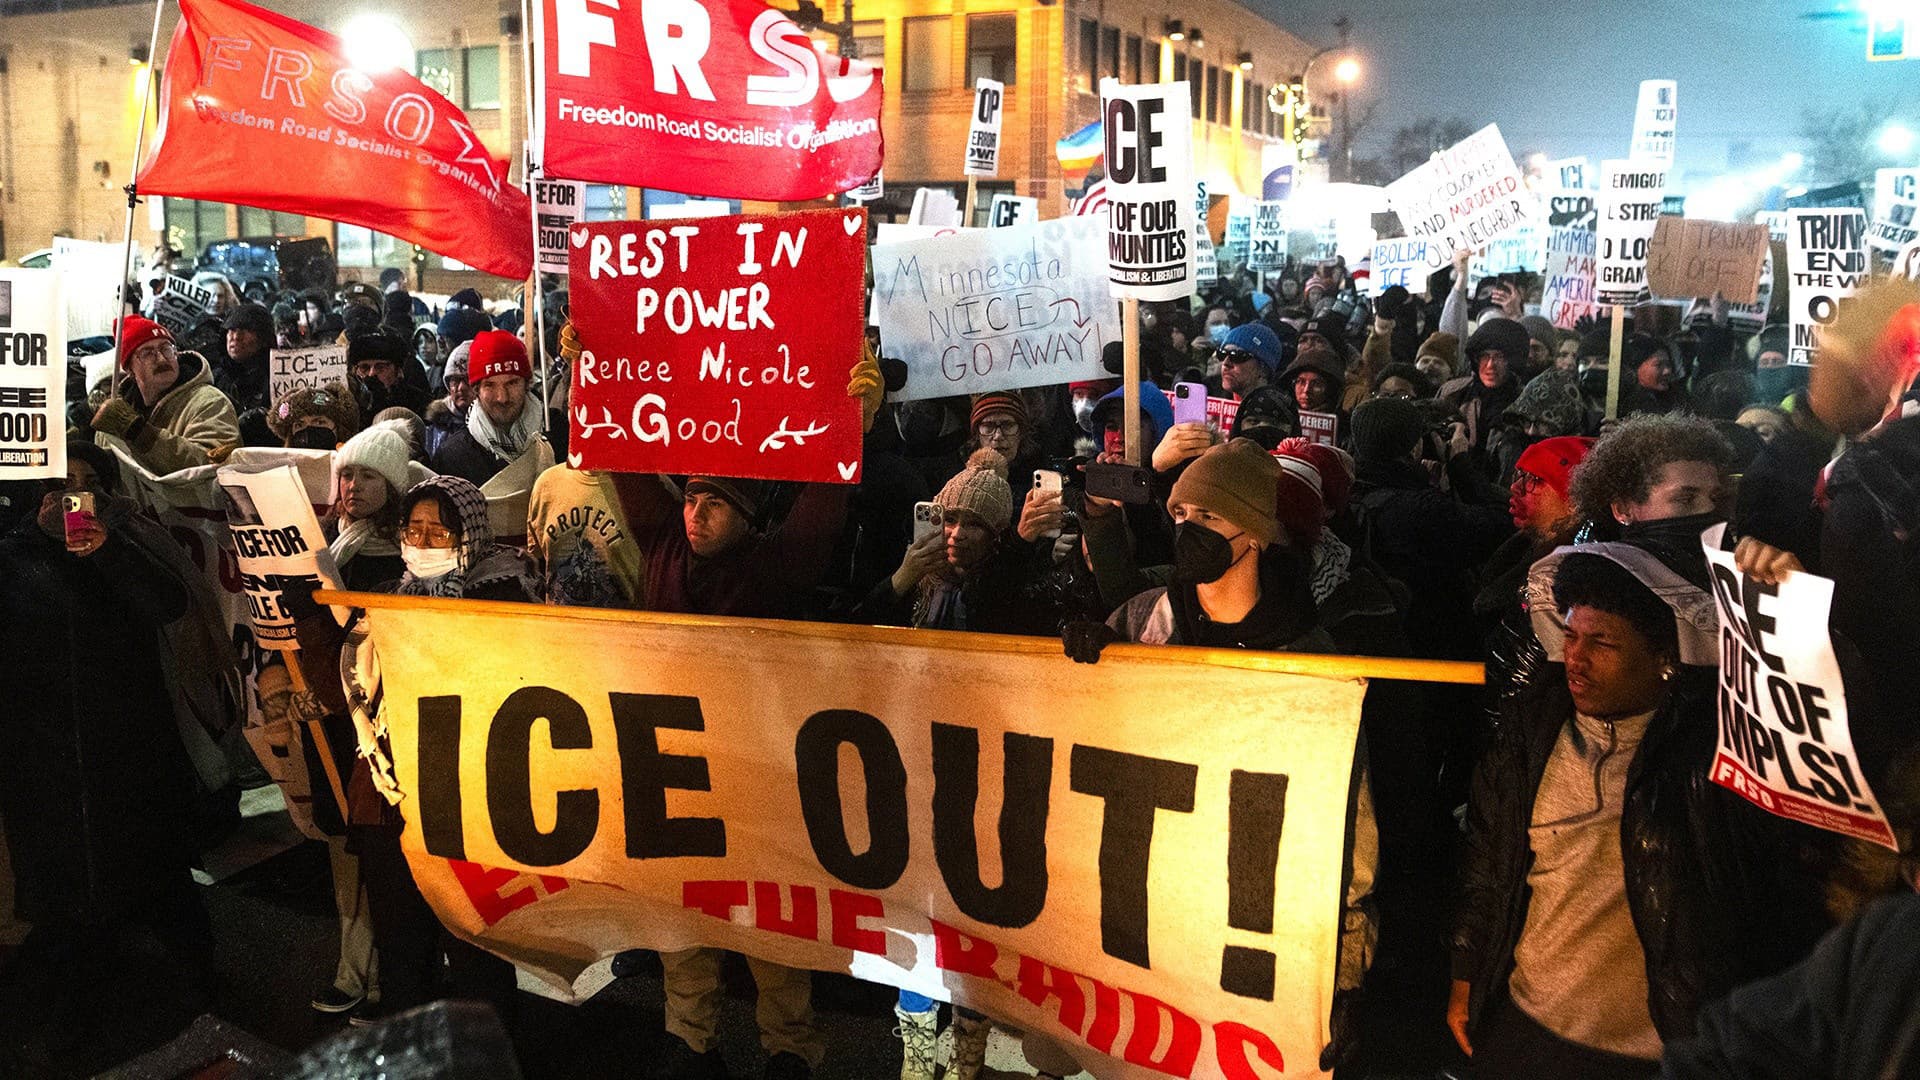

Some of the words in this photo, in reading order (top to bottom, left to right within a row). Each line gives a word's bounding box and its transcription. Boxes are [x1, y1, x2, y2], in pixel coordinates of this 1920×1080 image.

[200, 36, 434, 146] FRSO
[977, 88, 999, 124] OP
[280, 117, 331, 144] Road
[334, 128, 411, 161] Socialist
[558, 98, 655, 132] Freedom
[657, 114, 700, 140] Road
[704, 121, 783, 149] Socialist
[786, 117, 877, 153] Organion
[1103, 97, 1167, 184] CE
[548, 184, 576, 206] FOR
[1612, 172, 1656, 189] EMIGO
[992, 200, 1021, 228] CE
[1116, 201, 1137, 233] OF
[1140, 200, 1177, 233] OUR
[1449, 175, 1517, 223] MURDERED
[1618, 203, 1662, 222] STREE
[1413, 213, 1446, 237] AND
[1552, 227, 1595, 256] IMMIG
[589, 226, 700, 280] REST
[736, 222, 808, 276] IN
[1109, 229, 1186, 266] MUNITIES
[1372, 241, 1428, 267] ABOLISH
[1427, 236, 1456, 269] OUR
[1807, 252, 1865, 273] END
[887, 235, 1065, 305] Minnesota
[1379, 267, 1412, 290] ICE
[1794, 273, 1833, 288] THE
[167, 295, 203, 319] CE
[168, 275, 212, 308] KILLER
[635, 282, 776, 335] POWER
[928, 291, 1037, 342] NICE
[274, 354, 318, 376] ICE
[319, 355, 347, 366] WILL
[485, 361, 520, 376] FRSO
[580, 350, 673, 388] Renee
[699, 341, 816, 390] Nicole
[940, 342, 993, 382] GO
[1007, 321, 1105, 372] AWAY!
[0, 412, 47, 443] OOD
[632, 393, 743, 448] Good
[263, 525, 309, 557] FOR
[546, 505, 625, 546] PROTECT
[1712, 562, 1786, 676] CE
[1723, 625, 1762, 724] OUT
[1767, 674, 1832, 747] OF
[1721, 683, 1876, 814] MPLS!
[1717, 760, 1774, 810] FRSO
[416, 685, 728, 867] ICE
[797, 707, 1291, 1002] OUT!
